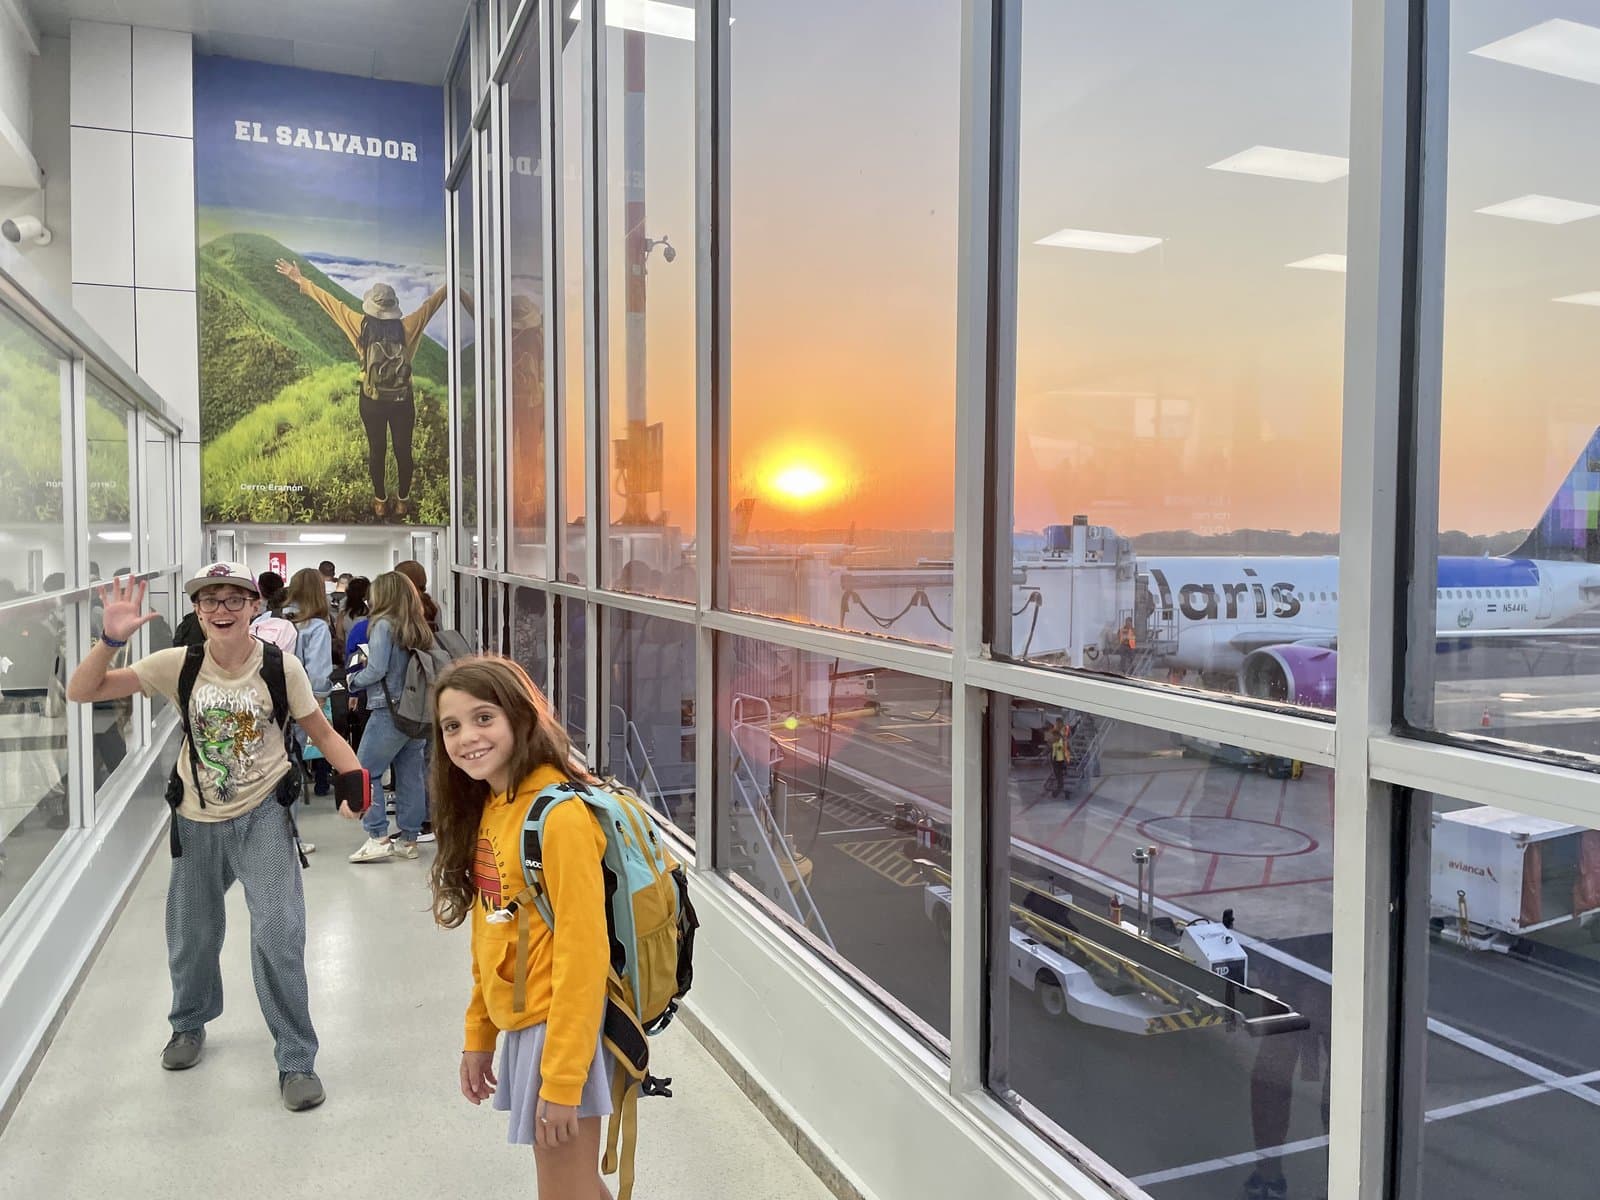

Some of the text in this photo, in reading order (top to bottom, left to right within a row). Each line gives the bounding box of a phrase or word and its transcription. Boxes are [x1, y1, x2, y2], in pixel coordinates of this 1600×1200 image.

[234, 120, 418, 162] EL SALVADOR
[240, 483, 304, 492] Cerro Eramón
[1148, 568, 1301, 621] laris
[1448, 860, 1485, 877] avianca
